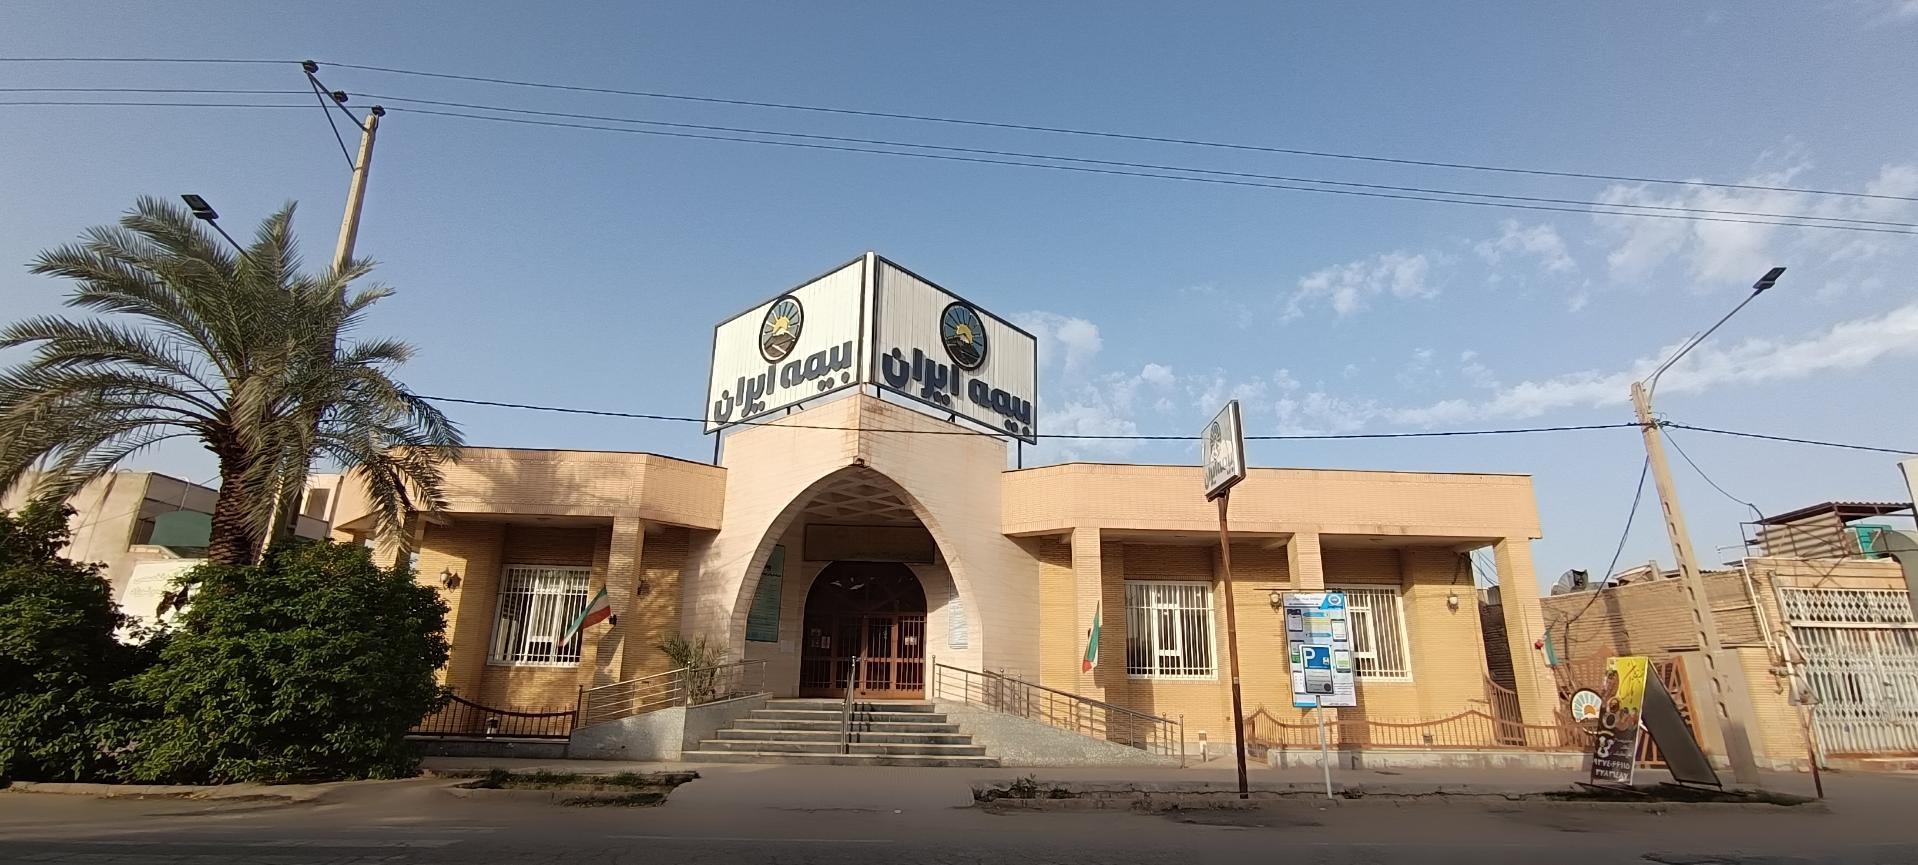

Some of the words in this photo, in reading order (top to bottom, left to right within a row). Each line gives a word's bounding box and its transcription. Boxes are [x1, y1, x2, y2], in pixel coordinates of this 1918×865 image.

[714, 363, 776, 424] ایران
[780, 340, 852, 391] بیمه
[882, 347, 958, 405] ایران
[968, 378, 1031, 437] بیمه
[1304, 648, 1315, 667] P
